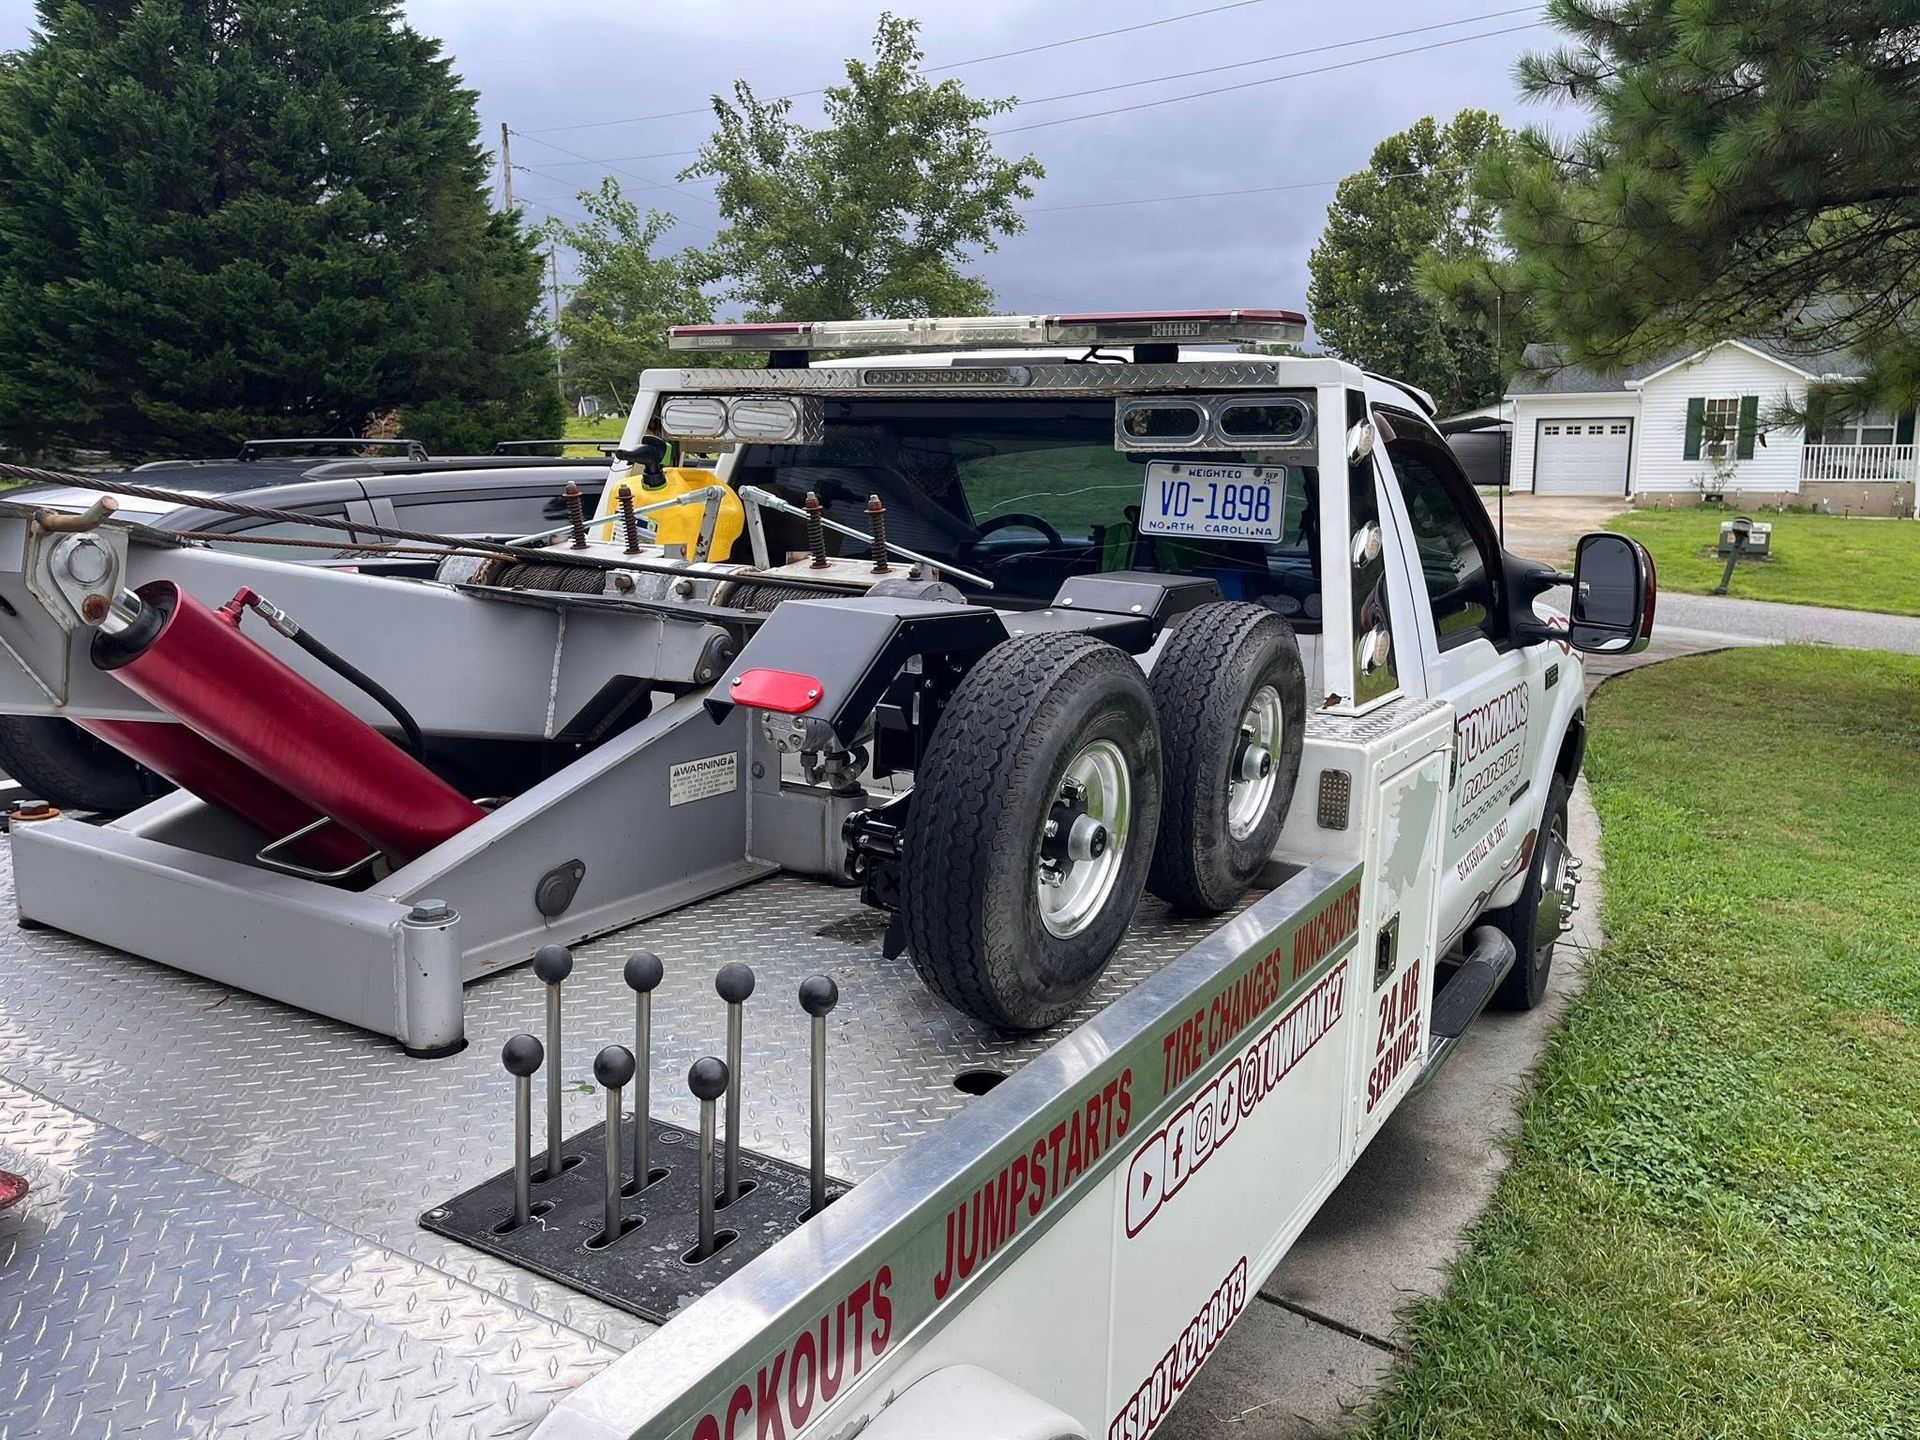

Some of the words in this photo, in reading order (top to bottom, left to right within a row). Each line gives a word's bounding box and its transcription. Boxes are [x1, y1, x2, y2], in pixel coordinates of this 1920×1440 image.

[1188, 468, 1242, 479] WEIGHTED
[1161, 480, 1271, 523] VD-1898
[1204, 523, 1273, 537] CAROLINA
[1457, 680, 1530, 768] TOWMANS
[679, 757, 728, 775] WARNING
[1461, 743, 1520, 808] ROADSIDE
[1457, 838, 1488, 882] STATESVILLE
[1376, 982, 1398, 1058] 24
[1399, 958, 1421, 1029] HR
[1366, 1009, 1423, 1115] SERVICE
[691, 1264, 893, 1440] CKOUTS
[932, 1067, 1133, 1301] JUMPSTARTS
[1162, 1007, 1205, 1097] TIRE
[1207, 947, 1282, 1057] CHANGES
[1292, 882, 1361, 982] WINCHOUTS
